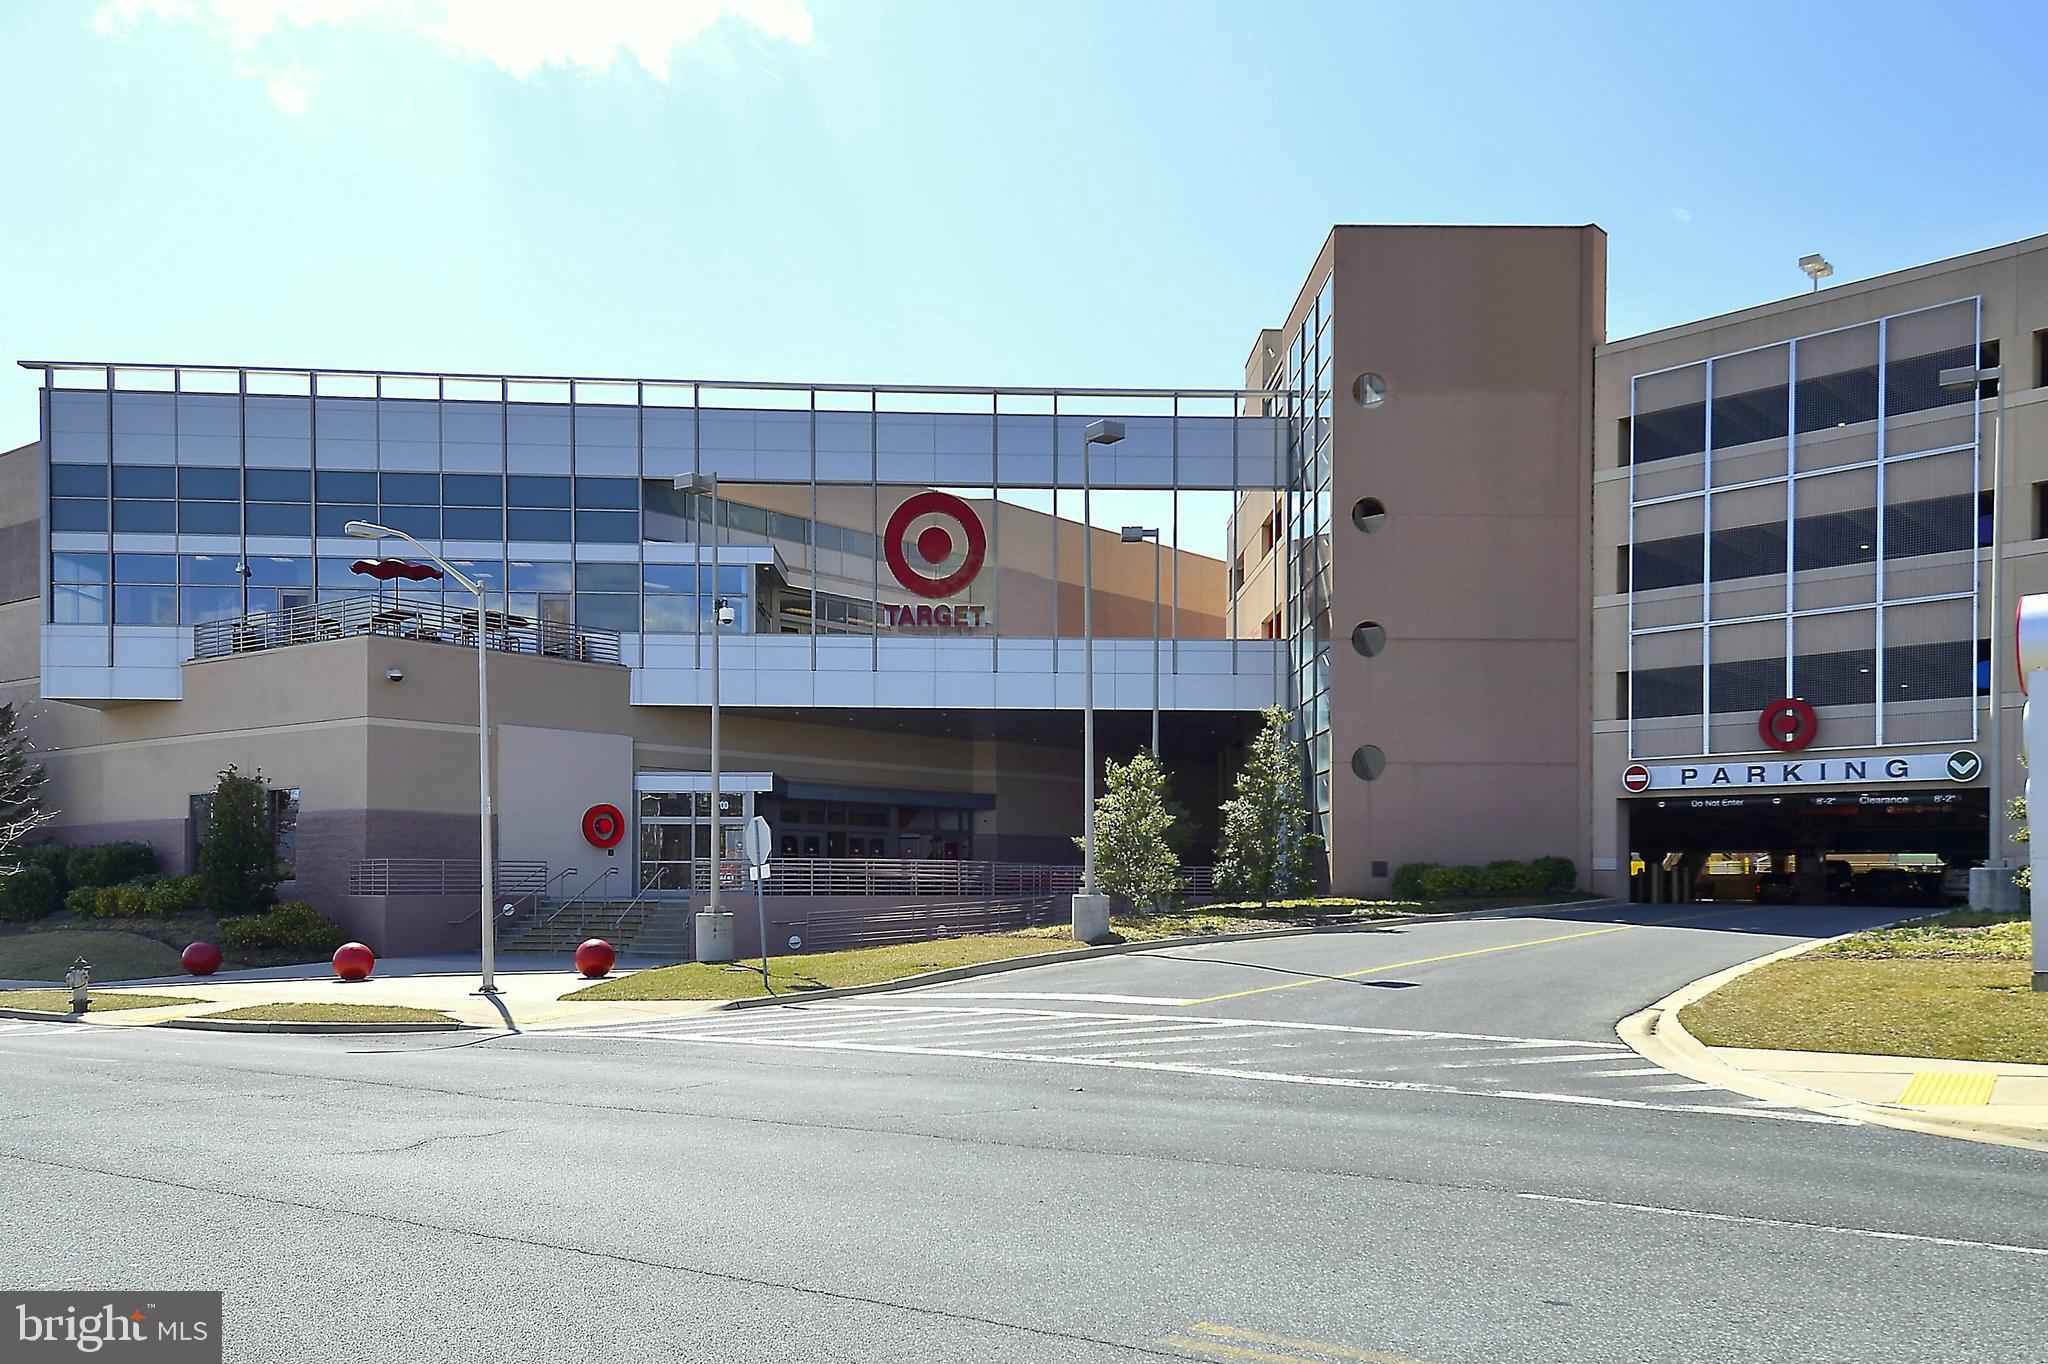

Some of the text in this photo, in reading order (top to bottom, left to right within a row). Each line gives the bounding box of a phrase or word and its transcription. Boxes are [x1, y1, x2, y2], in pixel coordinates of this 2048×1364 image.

[883, 604, 985, 626] TARGET
[1680, 759, 1910, 785] PARKING
[1859, 796, 1909, 804] Clearance
